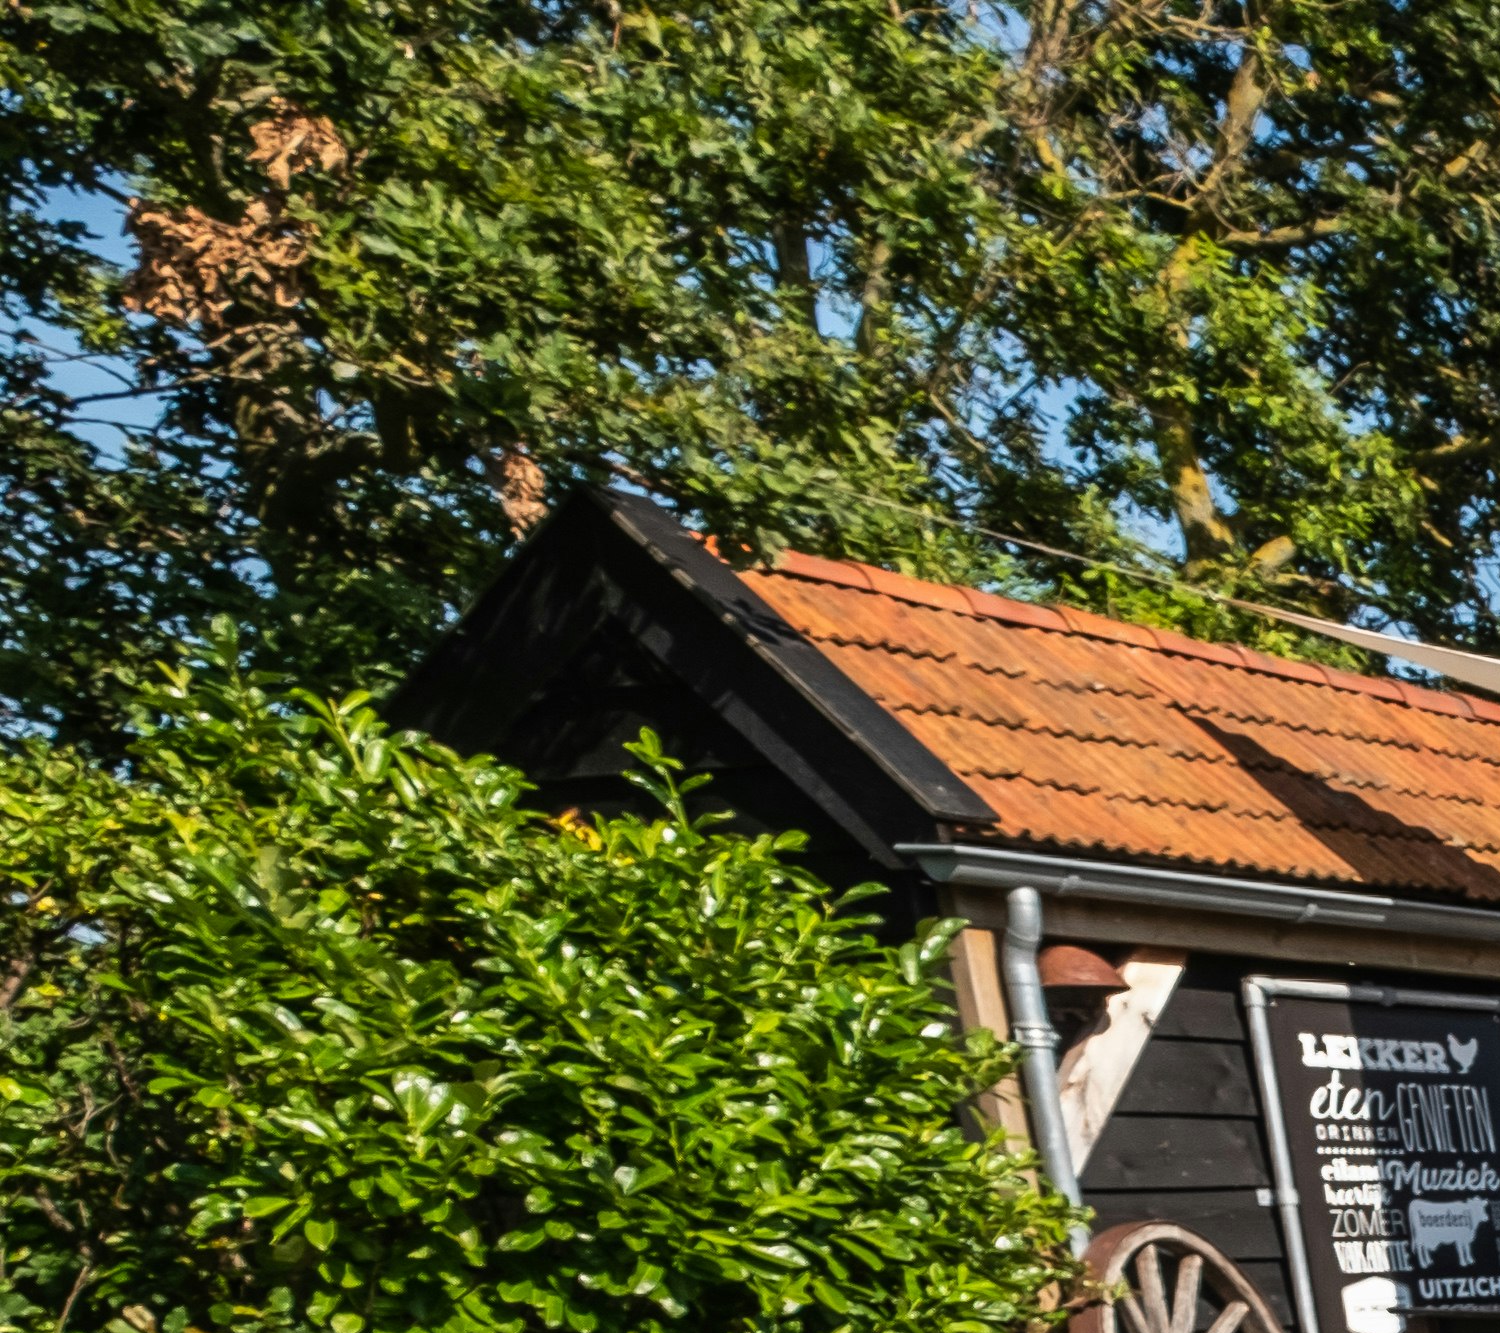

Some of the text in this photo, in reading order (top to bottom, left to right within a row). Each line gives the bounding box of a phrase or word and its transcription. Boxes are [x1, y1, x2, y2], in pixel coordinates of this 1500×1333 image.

[1298, 1033, 1449, 1073] LEKKER
[1310, 1070, 1395, 1120] eten
[1316, 1124, 1399, 1141] DRINKEN
[1397, 1082, 1496, 1154] GENIETEN
[1386, 1160, 1500, 1196] Muziek
[1329, 1208, 1406, 1238] ZOMER
[1333, 1240, 1414, 1274] VAKANTIE
